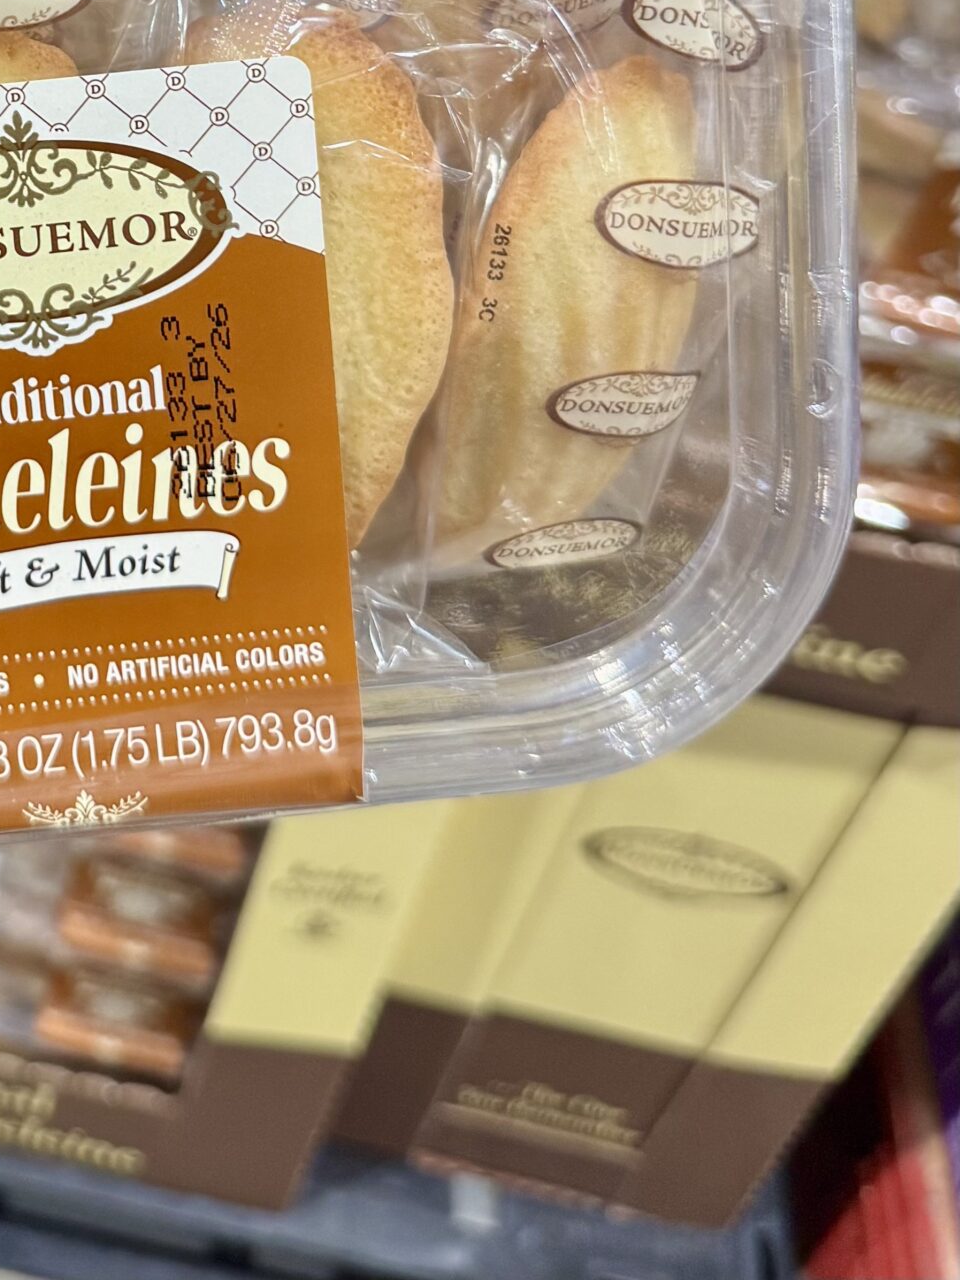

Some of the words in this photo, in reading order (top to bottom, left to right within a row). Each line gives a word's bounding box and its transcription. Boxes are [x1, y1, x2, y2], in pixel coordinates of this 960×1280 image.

[486, 223, 513, 281] 26133
[478, 297, 498, 322] 3C
[185, 335, 209, 382] BY
[191, 395, 217, 498] BEST
[24, 555, 60, 588] &
[72, 545, 181, 583] Moist
[497, 536, 628, 559] DONSUEMOR
[67, 663, 98, 689] NO
[106, 650, 228, 685] ARTIFICIAL
[236, 641, 325, 673] COLORS
[16, 732, 66, 776] OZ
[71, 725, 150, 781] (1.75
[155, 718, 212, 767] LB)
[216, 708, 337, 757] 793.8g
